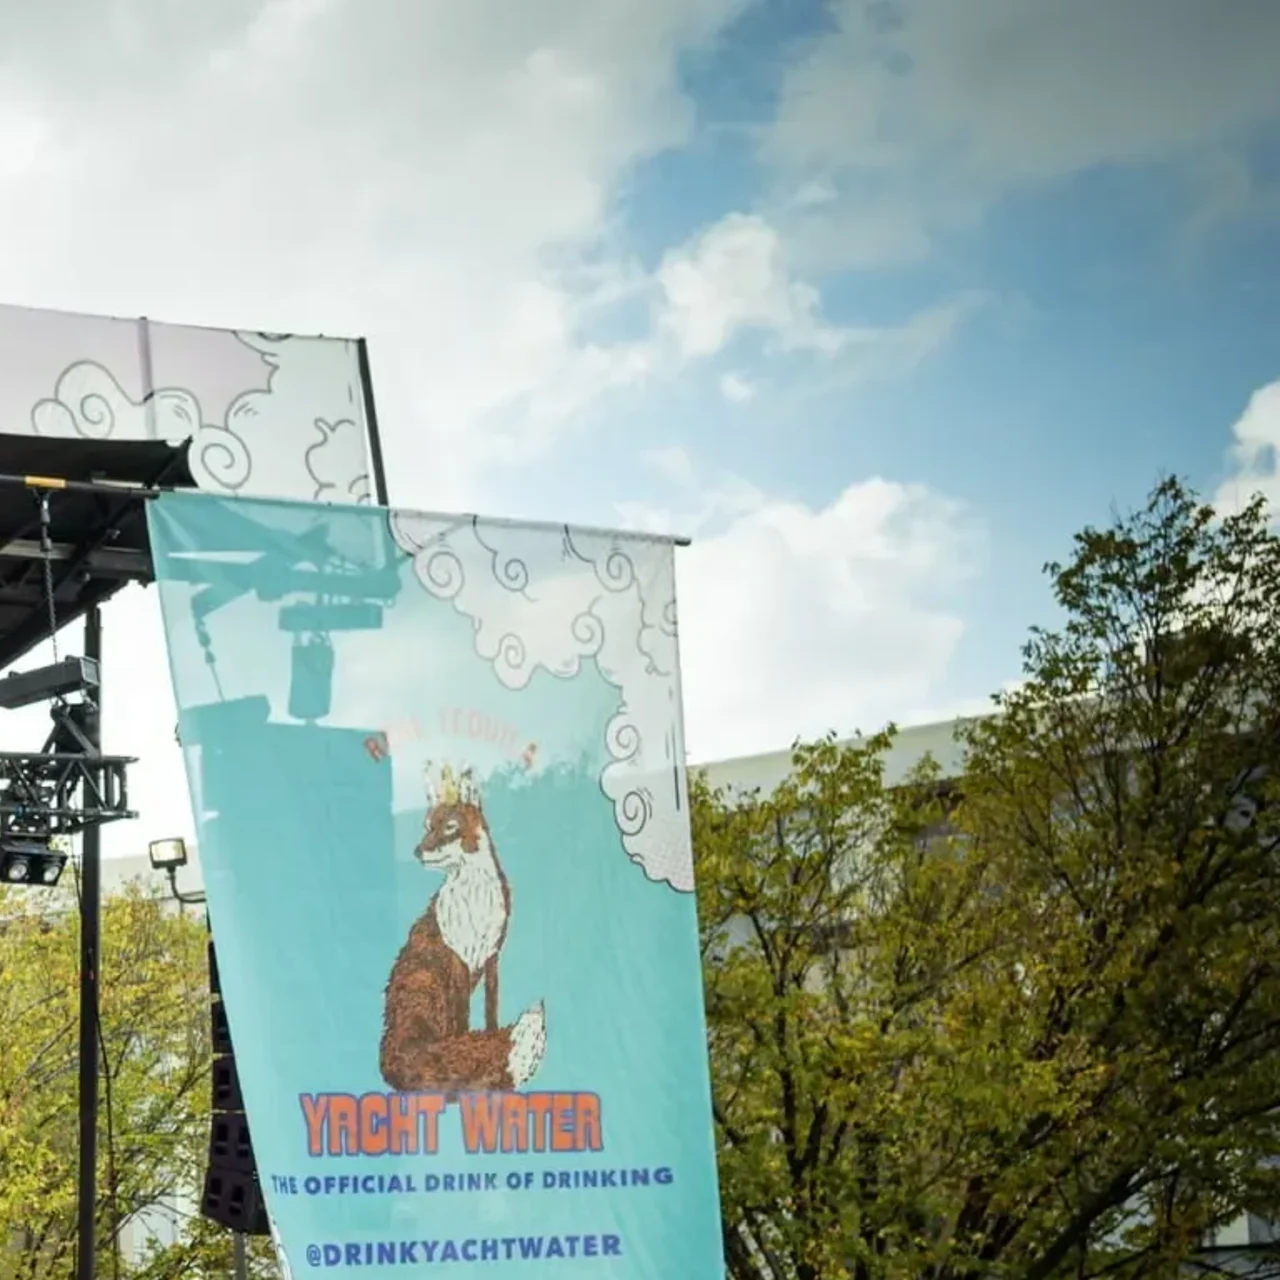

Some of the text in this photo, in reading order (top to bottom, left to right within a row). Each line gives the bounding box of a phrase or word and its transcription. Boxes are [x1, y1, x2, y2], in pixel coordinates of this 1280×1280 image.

[299, 1091, 604, 1157] YACHT WATER
[272, 1167, 674, 1195] THE OFFICIAL DRINK OF DRINKING
[305, 1234, 623, 1268] @DRINKYACHTWATER
